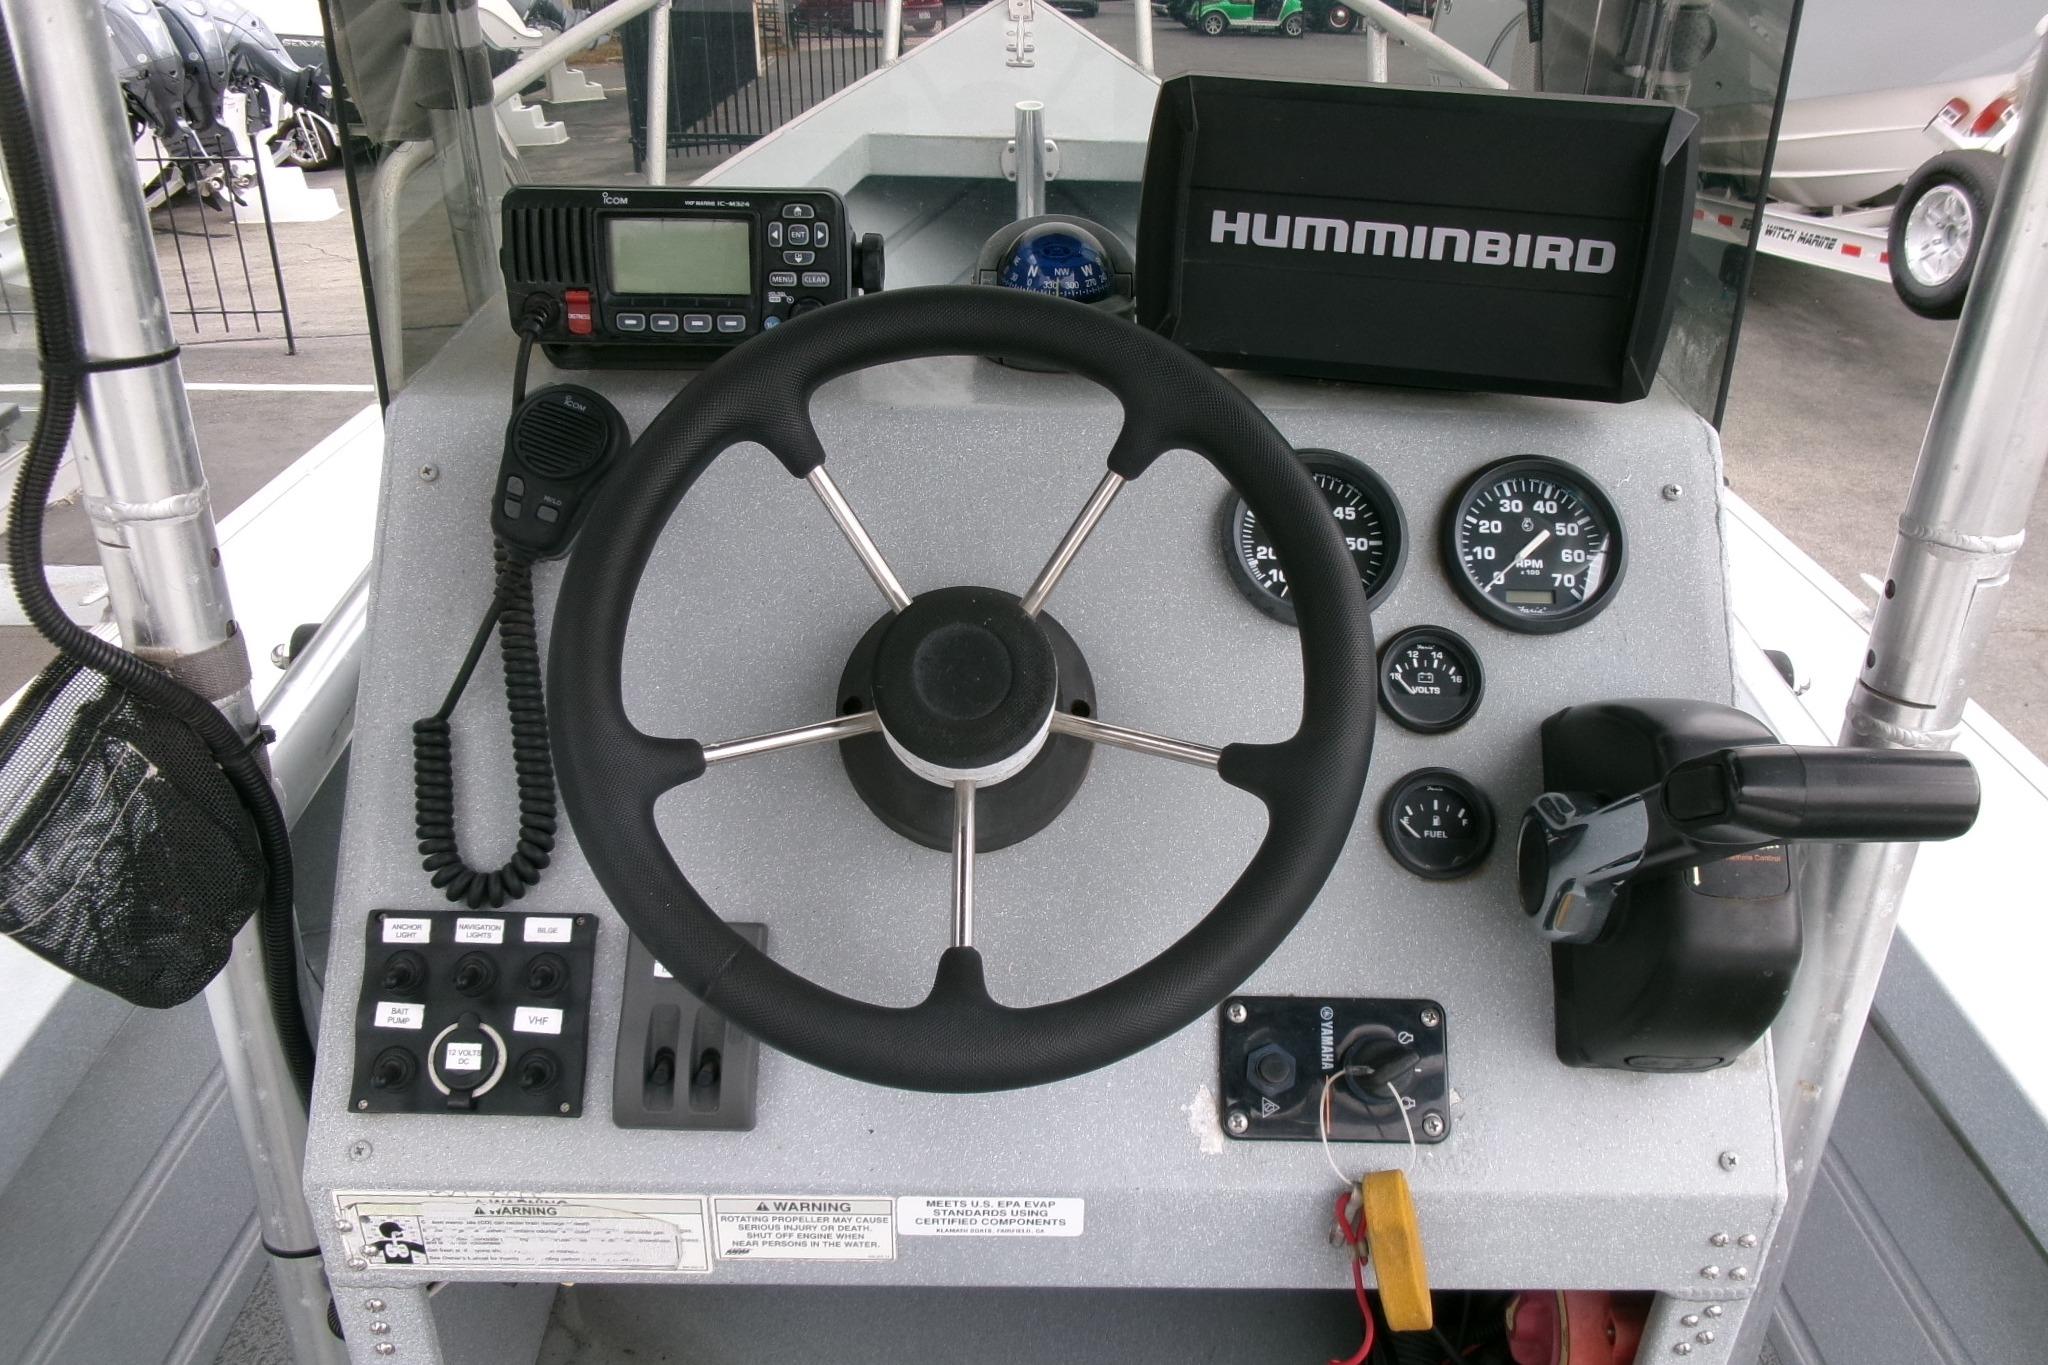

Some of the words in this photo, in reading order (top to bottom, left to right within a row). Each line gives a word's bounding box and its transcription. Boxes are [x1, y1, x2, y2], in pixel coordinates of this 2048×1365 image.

[791, 231, 805, 239] ENT
[1764, 223, 1797, 242] WITCH
[1797, 231, 1838, 251] MARINE
[1210, 210, 1617, 275] HUMMINBIRD
[1028, 266, 1038, 277] N
[1054, 268, 1069, 276] NW
[1081, 265, 1093, 276] W
[1064, 280, 1080, 289] 300
[1500, 499, 1523, 513] 30
[1533, 500, 1558, 514] 40
[1333, 506, 1356, 520] 45
[1478, 520, 1502, 534] 20
[1555, 522, 1579, 536] 50
[1345, 537, 1369, 551] 50
[1473, 546, 1496, 560] 10
[1561, 549, 1585, 563] 60
[1516, 559, 1544, 569] RPM
[1492, 571, 1505, 585] 0
[1551, 573, 1576, 587] 70
[1406, 650, 1419, 658] 12
[1430, 651, 1443, 659] 14
[1450, 675, 1463, 683] 16
[1411, 686, 1441, 695] VOLTS
[1403, 816, 1411, 825] E
[1462, 818, 1469, 827] F
[1423, 830, 1449, 839] FUEL
[458, 923, 501, 931] NAVIGATION
[466, 931, 492, 939] LIGHTS
[391, 1007, 409, 1015] BAIT
[387, 1016, 410, 1025] PUMP
[528, 1016, 549, 1026] VHF
[1320, 1022, 1335, 1070] YAMAHA
[448, 1049, 457, 1057] 12
[459, 1049, 481, 1057] VOLTS
[774, 1202, 851, 1212] WARNING
[926, 1200, 967, 1208] MEETS
[971, 1200, 993, 1208] U.S.
[1024, 1201, 1056, 1209] EVAP
[490, 1206, 558, 1216] WARNING
[933, 1209, 1007, 1217] STANDARDS
[720, 1215, 769, 1223] ROTATING
[772, 1216, 830, 1224] PROPELLER
[915, 1217, 978, 1225] CERTIFIED
[981, 1218, 1067, 1226] COMPONENTS
[820, 1224, 835, 1232] OR
[775, 1232, 794, 1240] OFF
[796, 1232, 833, 1240] ENGINE
[810, 1240, 820, 1248] IN
[823, 1240, 841, 1248] THE
